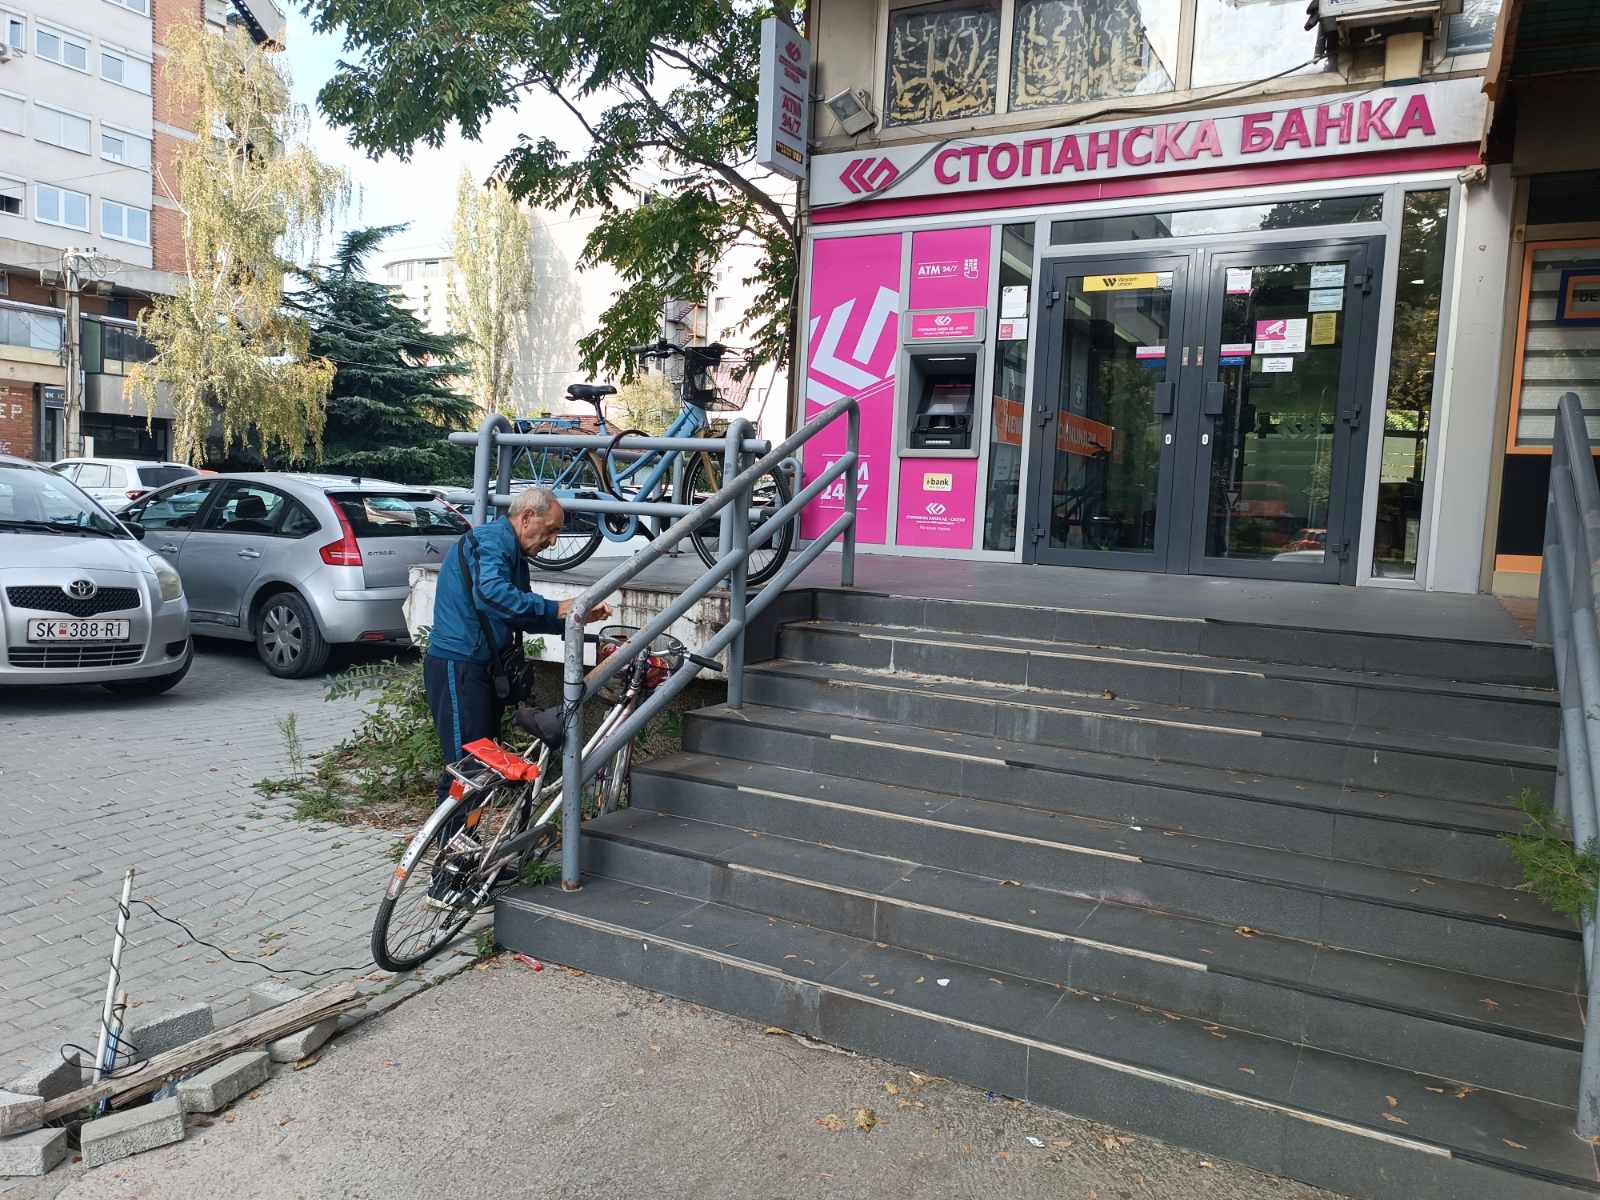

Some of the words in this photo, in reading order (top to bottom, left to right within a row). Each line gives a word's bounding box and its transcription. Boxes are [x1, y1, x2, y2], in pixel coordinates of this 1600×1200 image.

[934, 118, 1223, 185] СТОПАНСКА
[1240, 94, 1436, 155] БАНКА
[918, 265, 940, 276] ATM
[36, 622, 56, 637] SK
[69, 622, 121, 637] 388-RI
